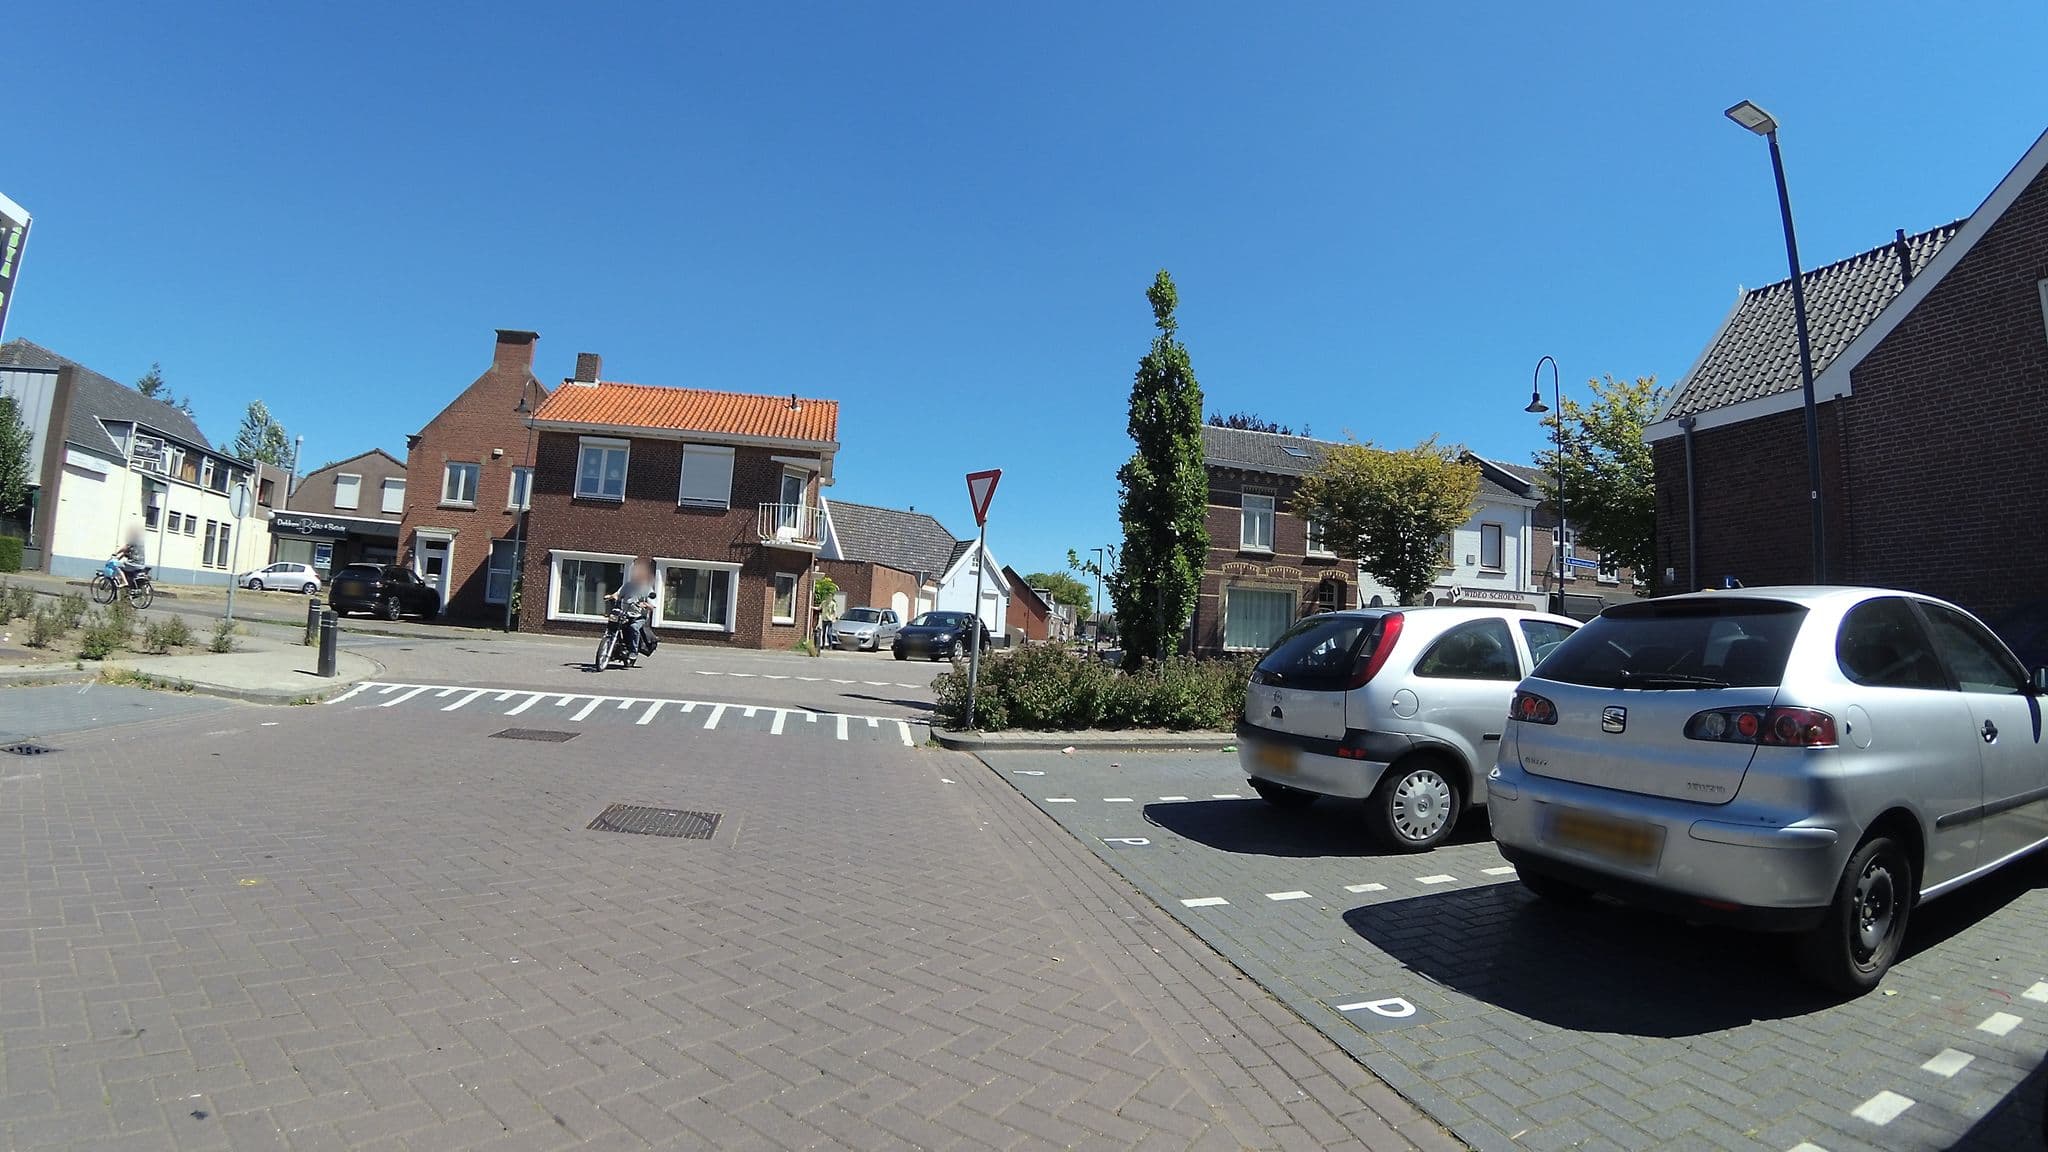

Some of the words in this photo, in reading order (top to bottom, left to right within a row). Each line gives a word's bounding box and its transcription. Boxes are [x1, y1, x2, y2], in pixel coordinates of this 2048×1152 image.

[1464, 590, 1488, 599] WIDEO
[1489, 591, 1525, 601] SCHOENEN
[1103, 837, 1150, 846] P
[1336, 997, 1417, 1018] P
